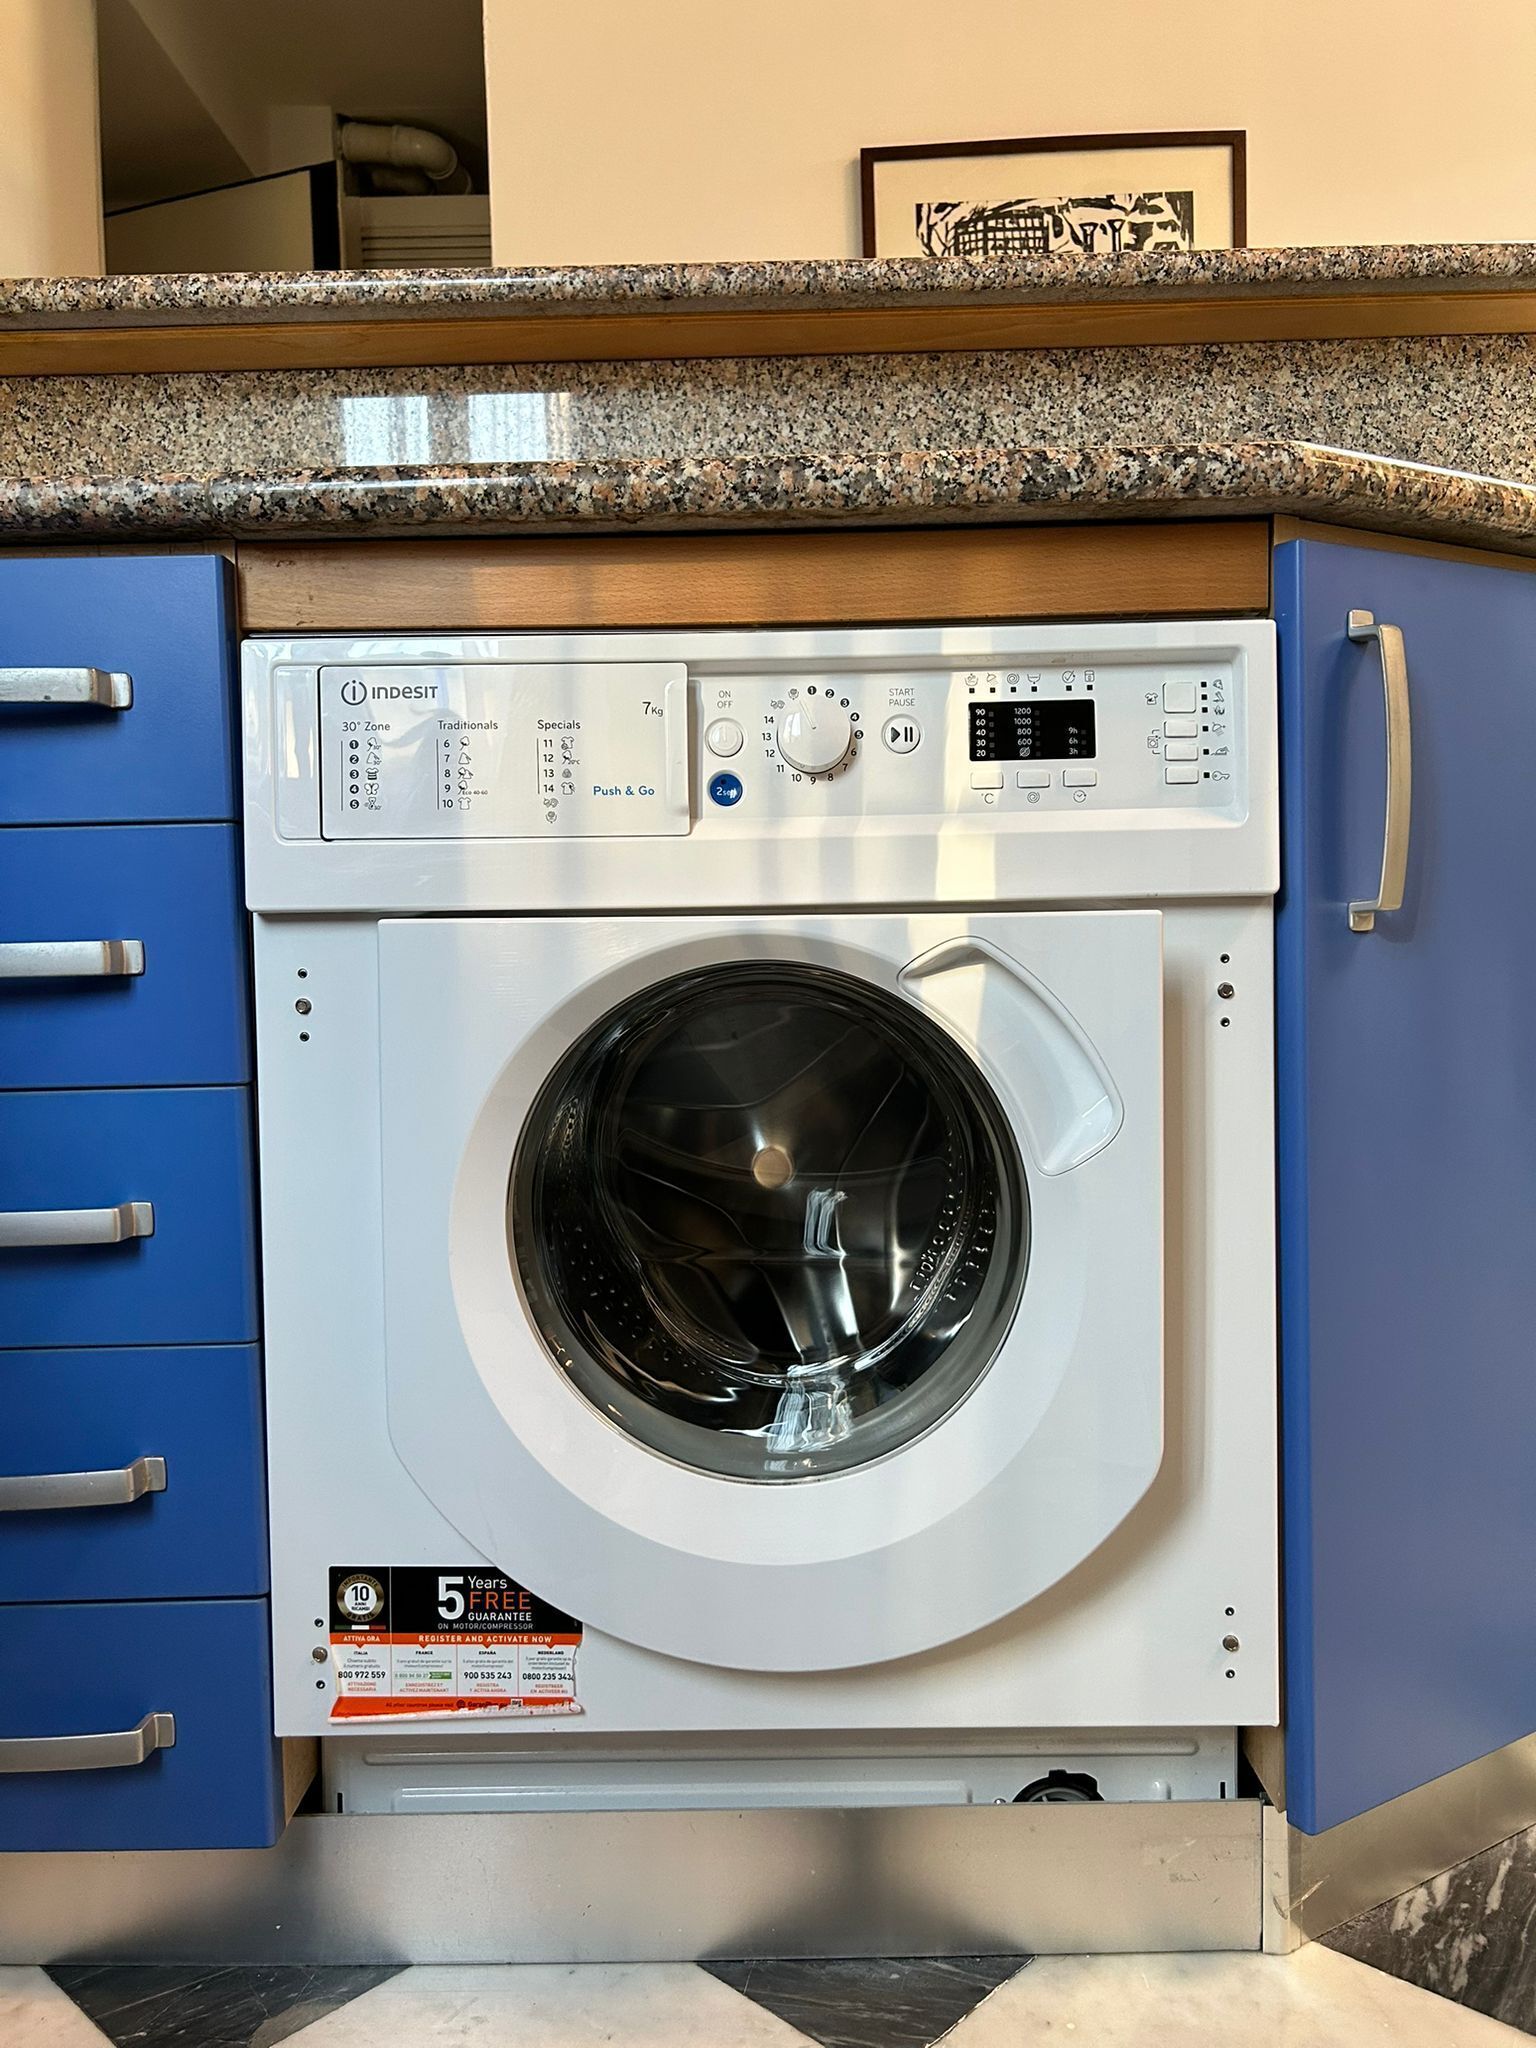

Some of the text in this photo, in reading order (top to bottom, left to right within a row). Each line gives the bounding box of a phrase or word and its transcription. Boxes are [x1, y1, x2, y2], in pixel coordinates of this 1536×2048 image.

[718, 690, 731, 698] ON
[889, 688, 915, 696] START
[717, 701, 733, 709] OFF
[889, 699, 915, 707] PAUSE
[975, 708, 986, 716] 90
[1014, 707, 1032, 715] 1200
[764, 716, 774, 724] 14
[342, 721, 391, 732] 30° Zone
[438, 720, 499, 730] Traditionals
[537, 719, 581, 731] Specials
[1068, 727, 1078, 735] 9h
[762, 733, 772, 741] 13
[1068, 737, 1078, 745] 6h
[443, 740, 450, 748] 6
[543, 739, 553, 748] 11
[976, 739, 986, 747] 30
[976, 749, 986, 757] 20
[1069, 747, 1078, 755] 3h
[445, 755, 450, 763] 7
[543, 754, 554, 763] 12
[444, 770, 451, 778] 8
[544, 769, 554, 778] 13
[828, 773, 834, 781] 8
[791, 774, 802, 782] 10
[810, 776, 816, 784] 9
[444, 785, 451, 793] 9
[544, 784, 554, 793] 14
[593, 785, 655, 796] Push & Go
[442, 800, 453, 808] 10
[342, 1574, 378, 1587] IMPORTANTE
[351, 1586, 370, 1601] 10
[437, 1575, 507, 1620] 5 Years
[469, 1592, 532, 1610] FREE
[346, 1611, 375, 1621] GRATIS
[468, 1612, 532, 1621] GUARANTEE
[419, 1635, 462, 1643] REGISTER
[487, 1635, 529, 1643] ACTIVATE
[338, 1671, 353, 1679] 800
[355, 1671, 369, 1679] 972
[371, 1671, 386, 1679] 559
